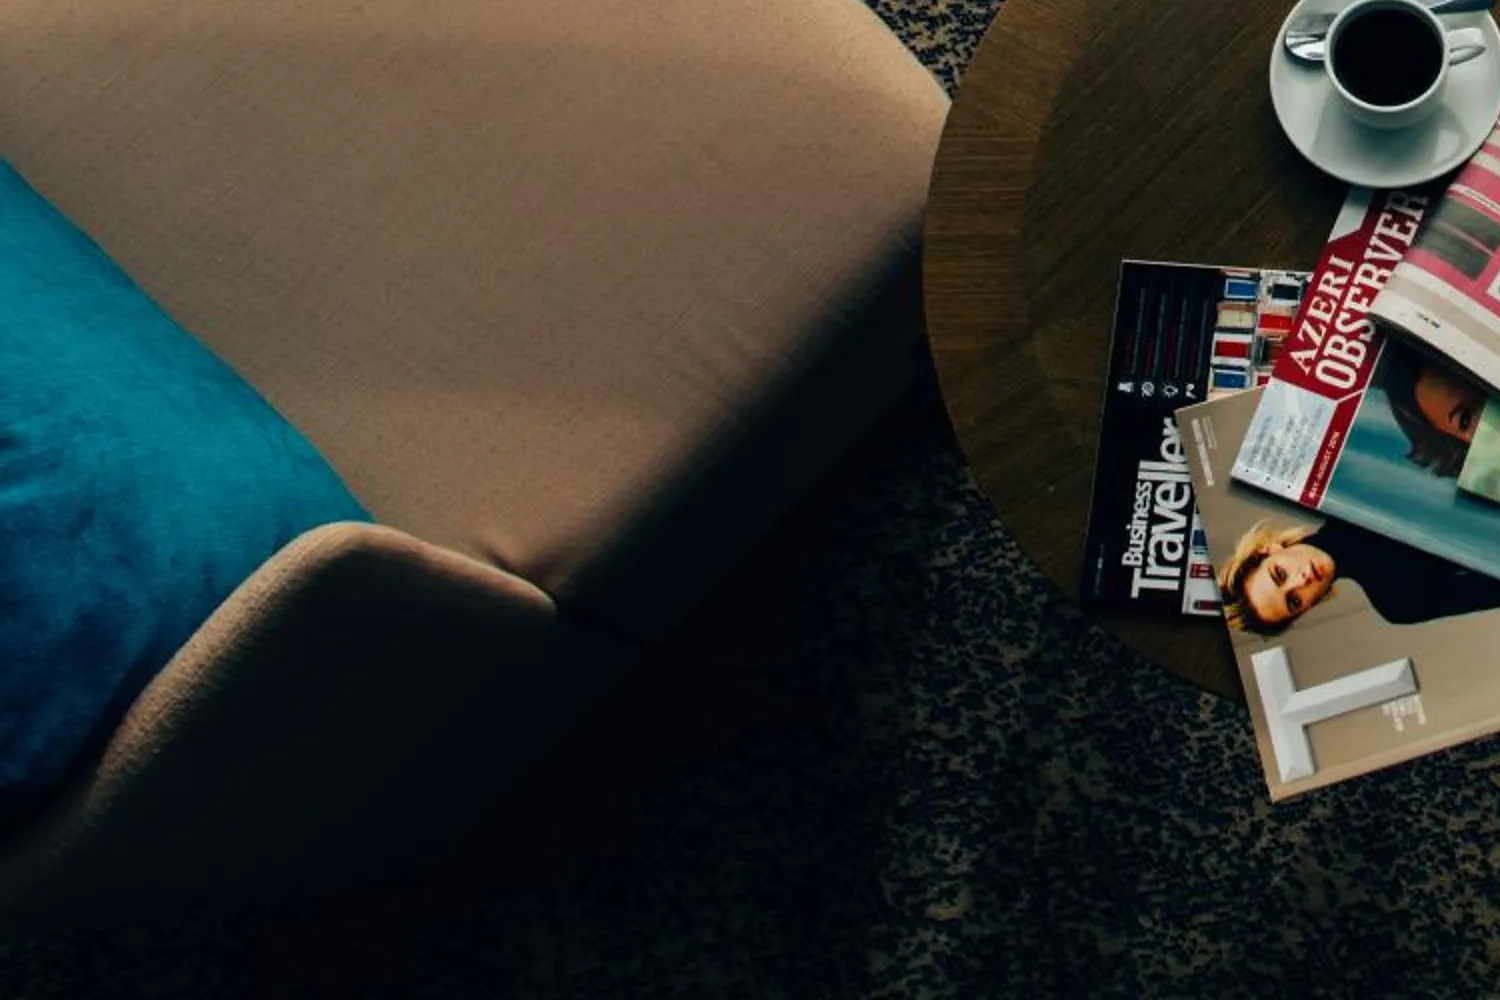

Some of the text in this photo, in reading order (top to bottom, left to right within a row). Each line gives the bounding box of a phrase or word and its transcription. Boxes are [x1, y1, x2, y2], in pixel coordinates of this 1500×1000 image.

[1289, 254, 1355, 376] AZERI
[1121, 481, 1153, 566] Business
[1251, 645, 1418, 784] T
